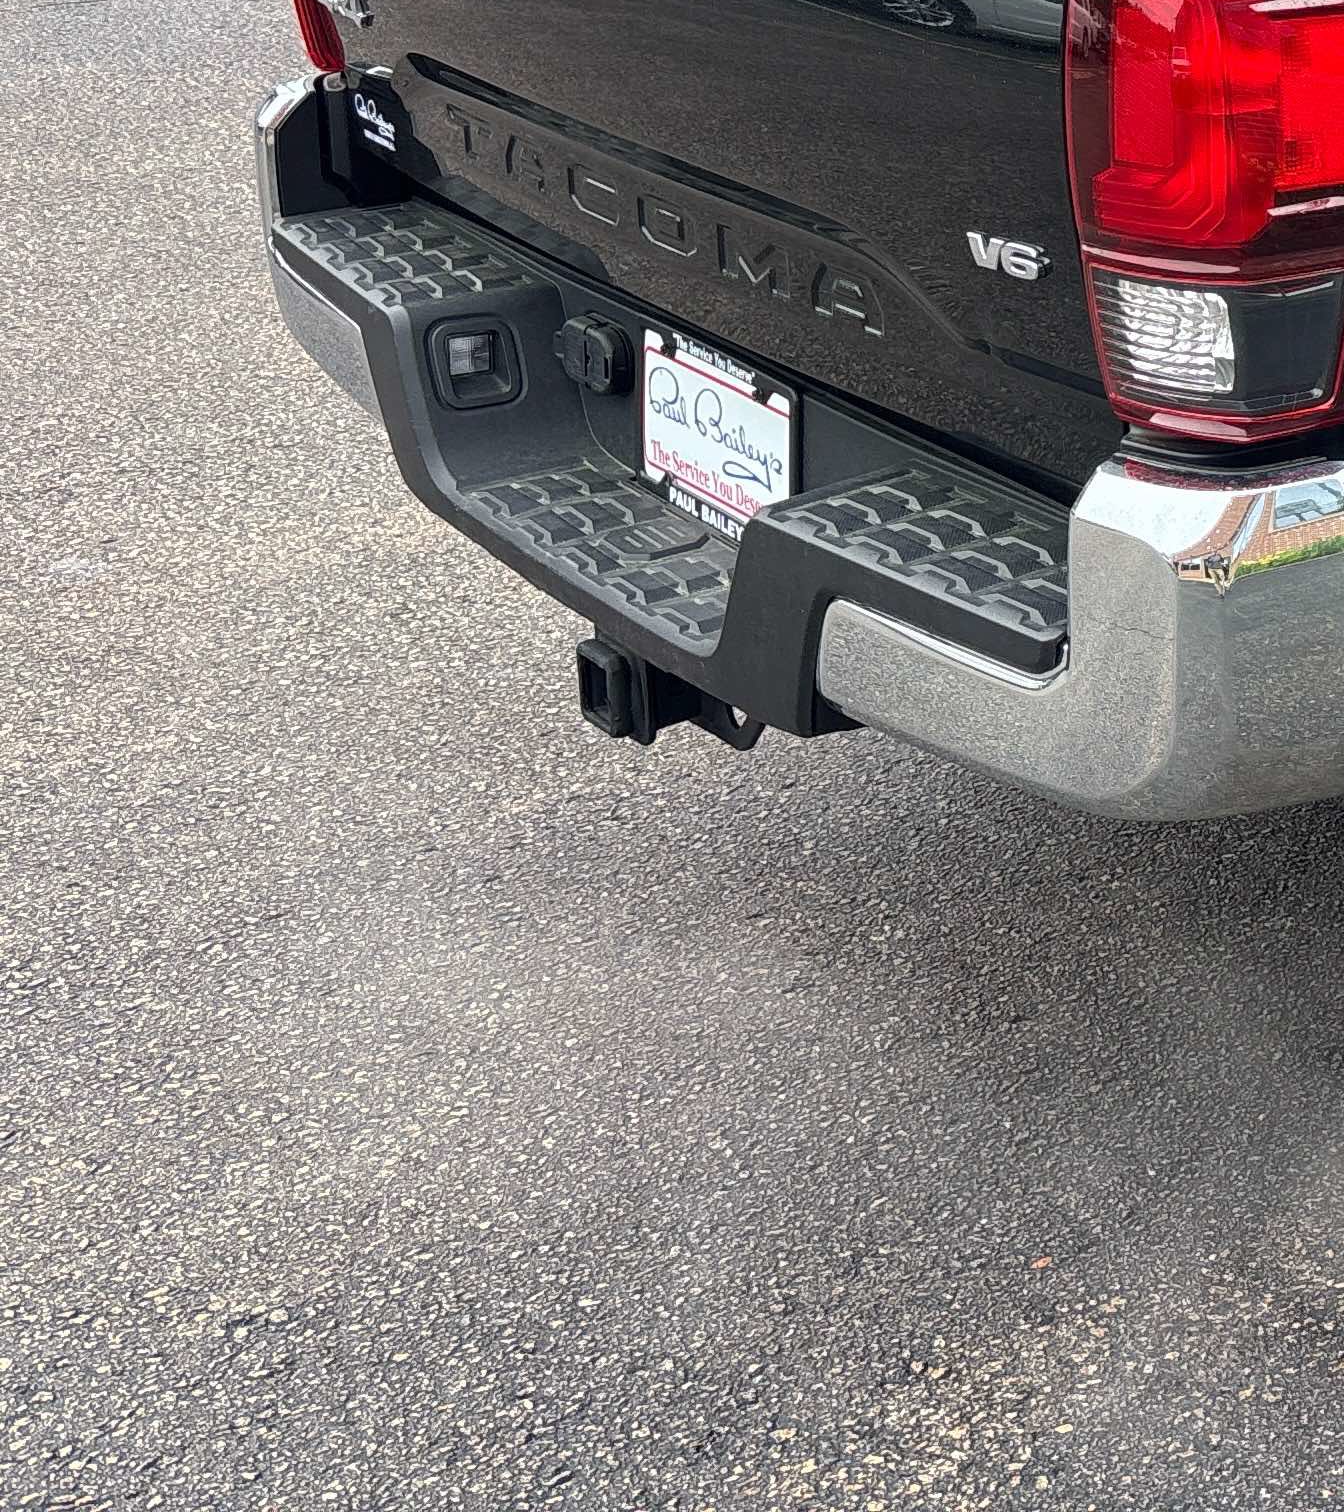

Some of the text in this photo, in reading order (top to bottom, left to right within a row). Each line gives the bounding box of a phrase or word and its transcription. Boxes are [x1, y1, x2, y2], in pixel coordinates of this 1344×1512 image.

[445, 104, 886, 337] TACOMA
[966, 231, 1046, 281] V6
[649, 366, 691, 429] Paul
[650, 439, 671, 468] The
[672, 450, 711, 489] Service
[711, 470, 733, 501] You
[669, 486, 745, 542] PAUL BAILEY
